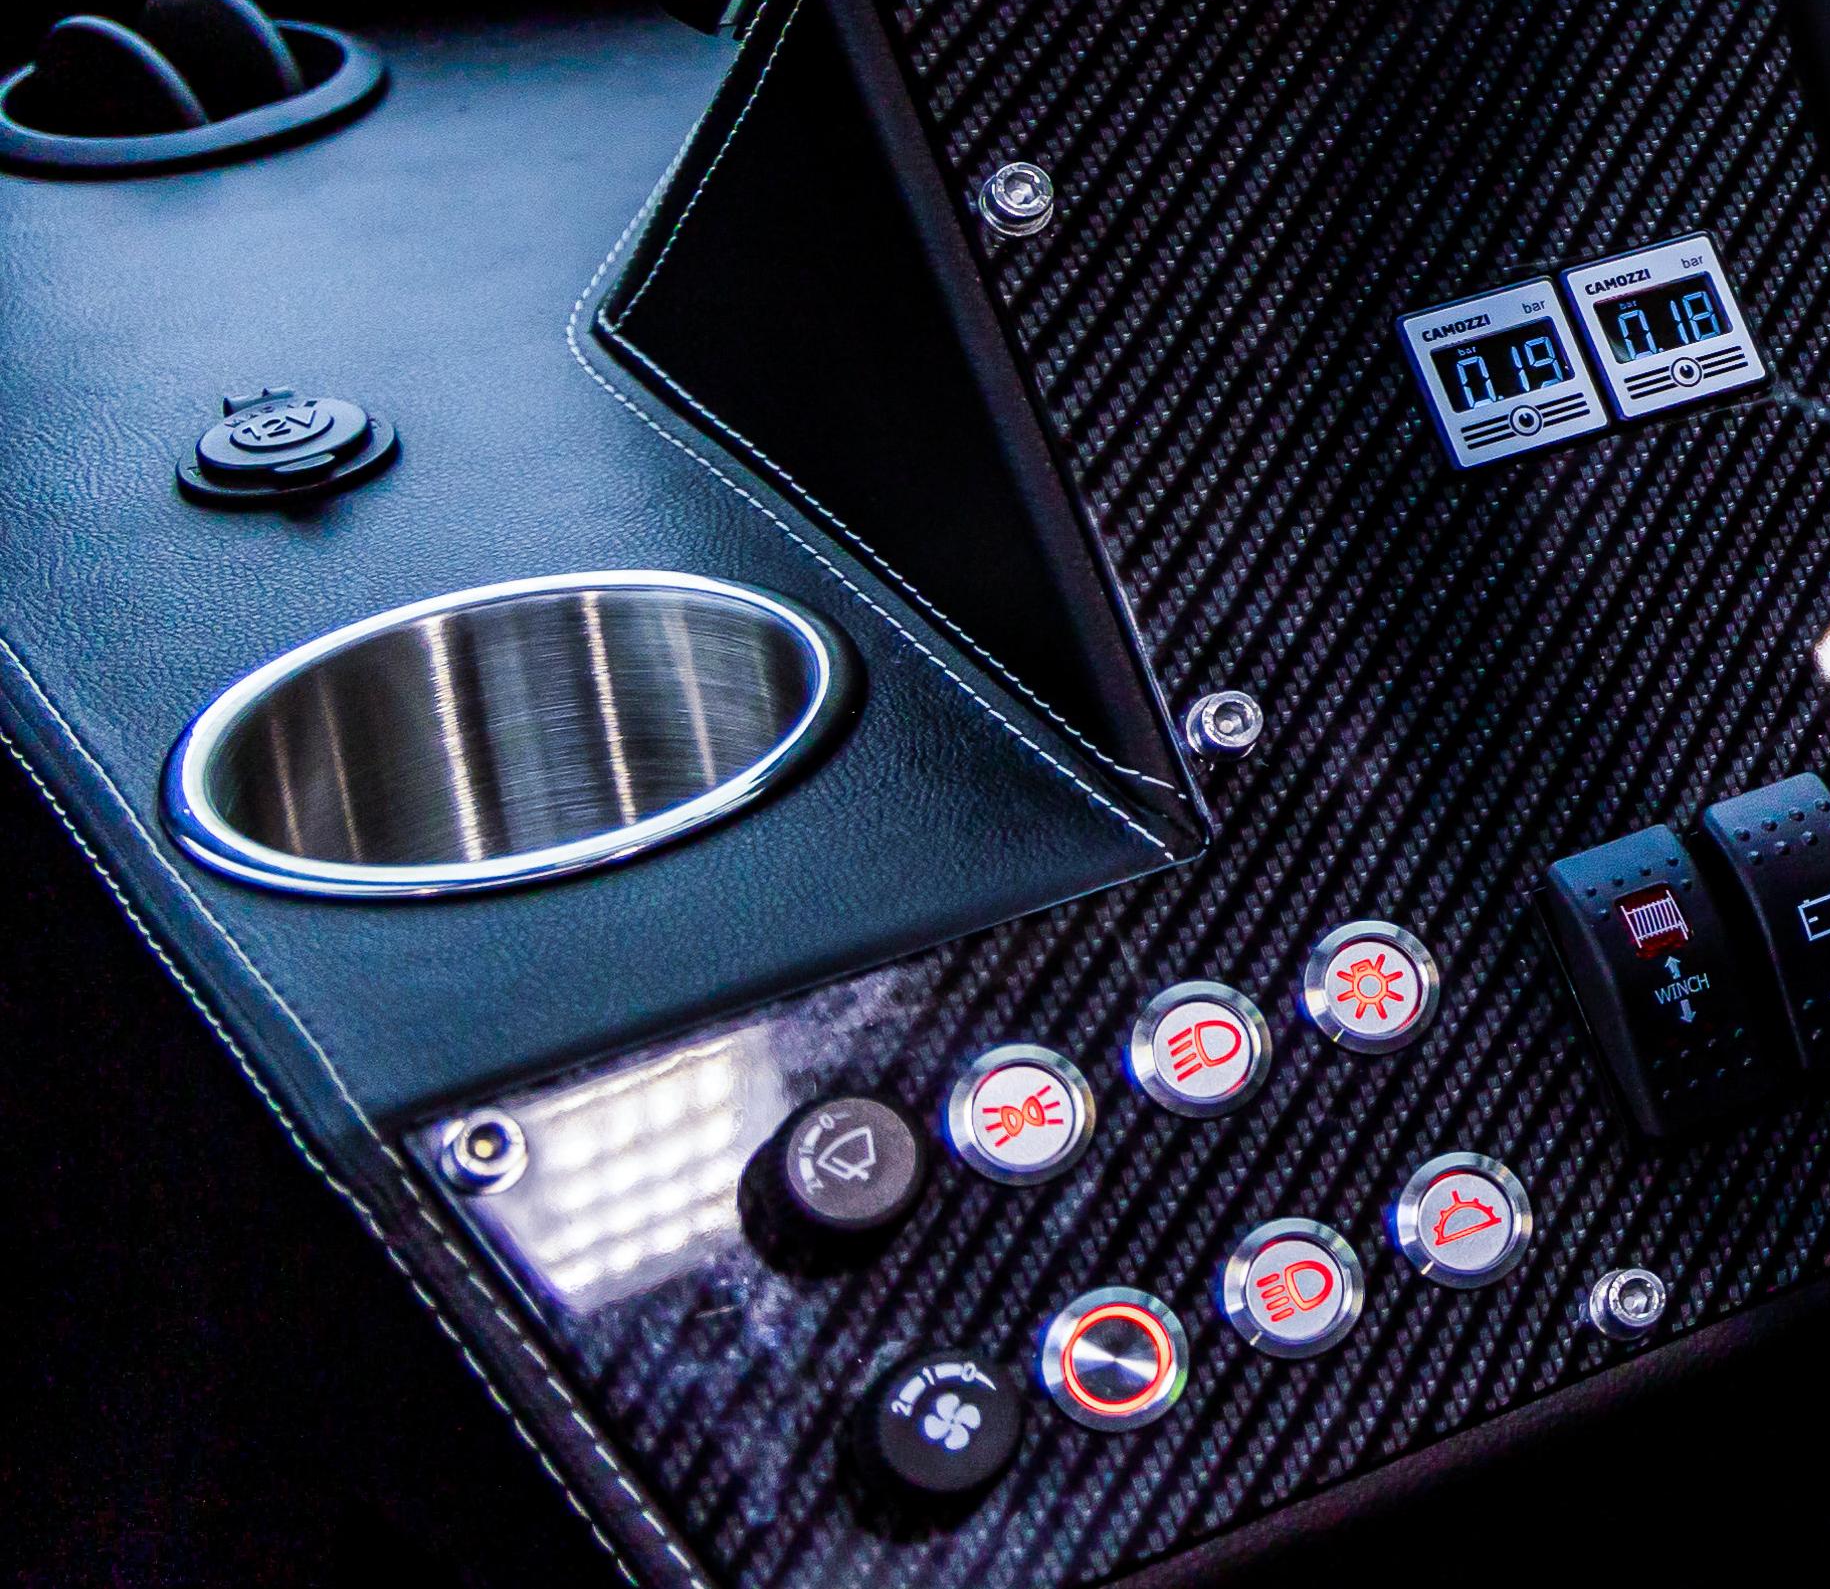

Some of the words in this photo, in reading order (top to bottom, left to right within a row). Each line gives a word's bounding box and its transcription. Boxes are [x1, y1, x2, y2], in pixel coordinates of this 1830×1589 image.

[1584, 268, 1651, 296] CAMOZZI
[1681, 254, 1705, 270] bar
[1422, 314, 1491, 343] CAMOZZI
[1522, 298, 1546, 315] bar
[1457, 344, 1477, 357] bar
[242, 410, 316, 441] 12V
[1655, 973, 1710, 1005] WINCH
